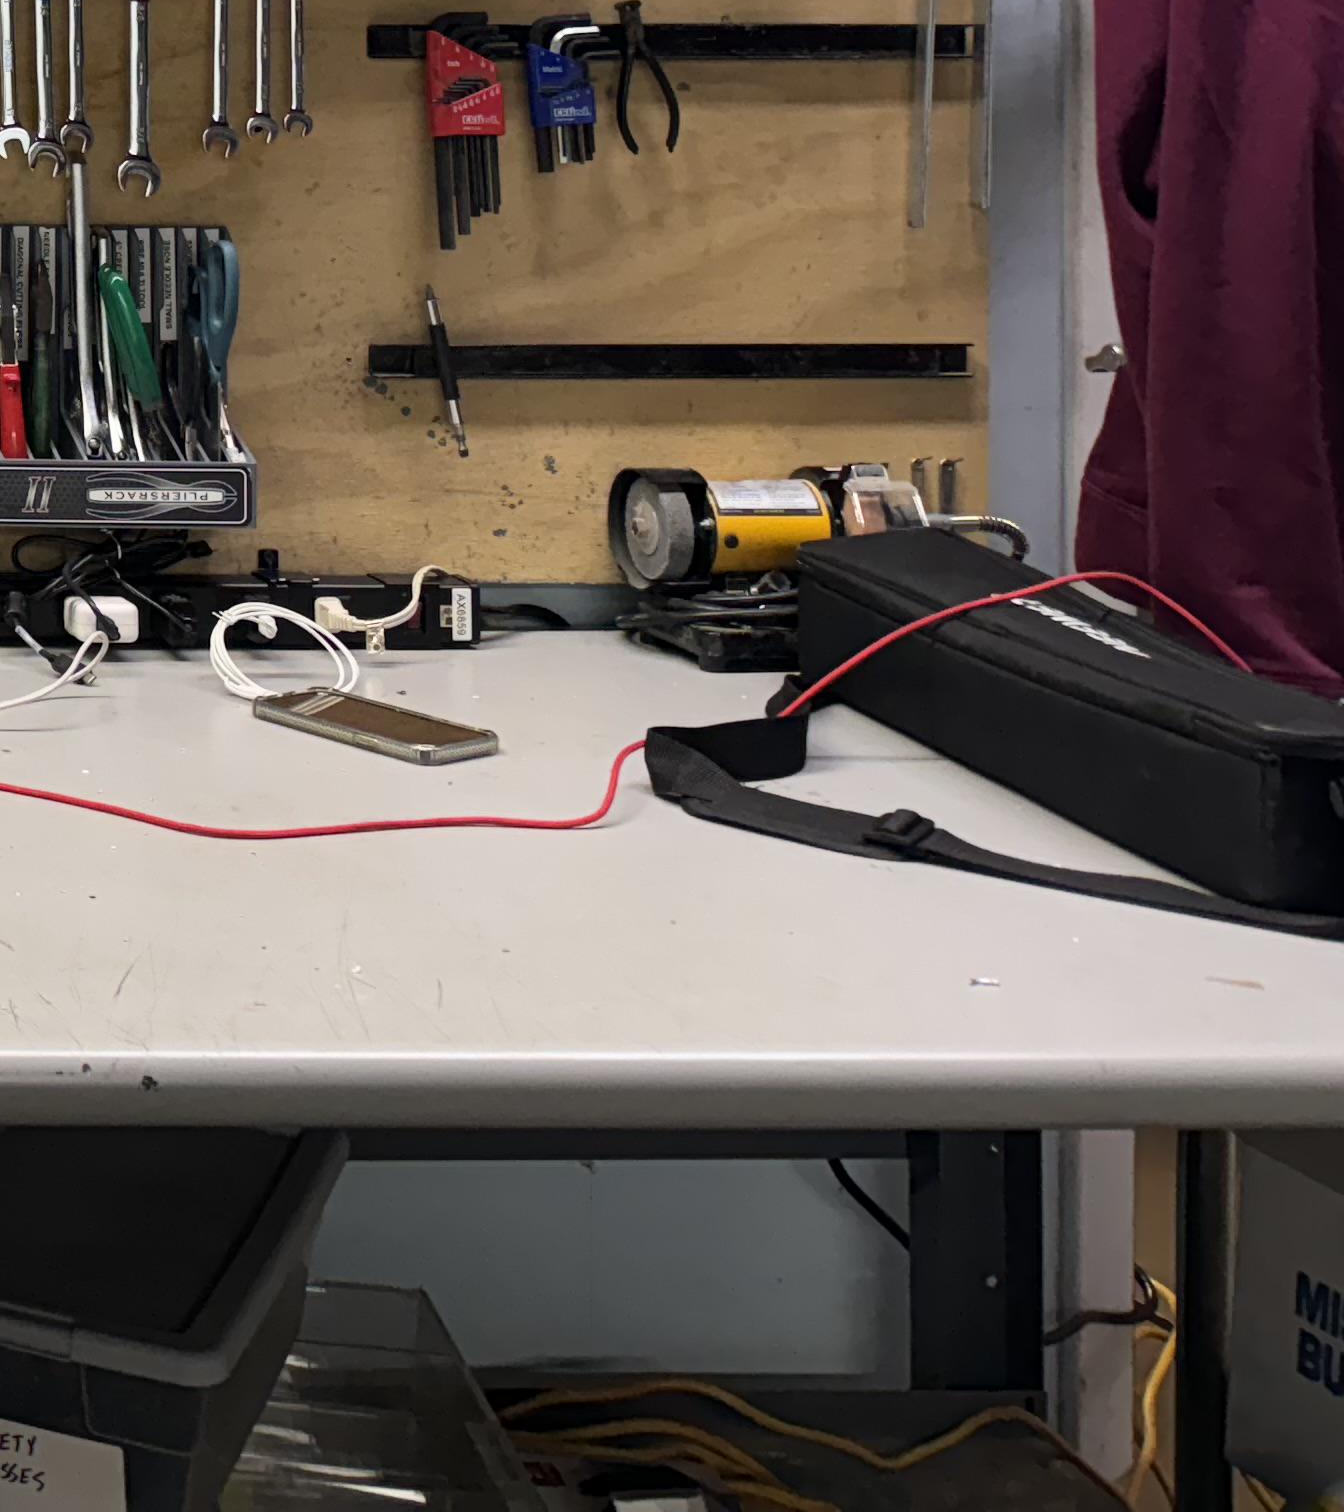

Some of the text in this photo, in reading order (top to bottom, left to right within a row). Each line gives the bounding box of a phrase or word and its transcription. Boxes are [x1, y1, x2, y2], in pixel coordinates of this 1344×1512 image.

[16, 237, 24, 278] DIAGONAL
[163, 266, 172, 299] NEEDLE
[164, 301, 173, 330] SMALL
[103, 489, 209, 502] PLIERSRACK
